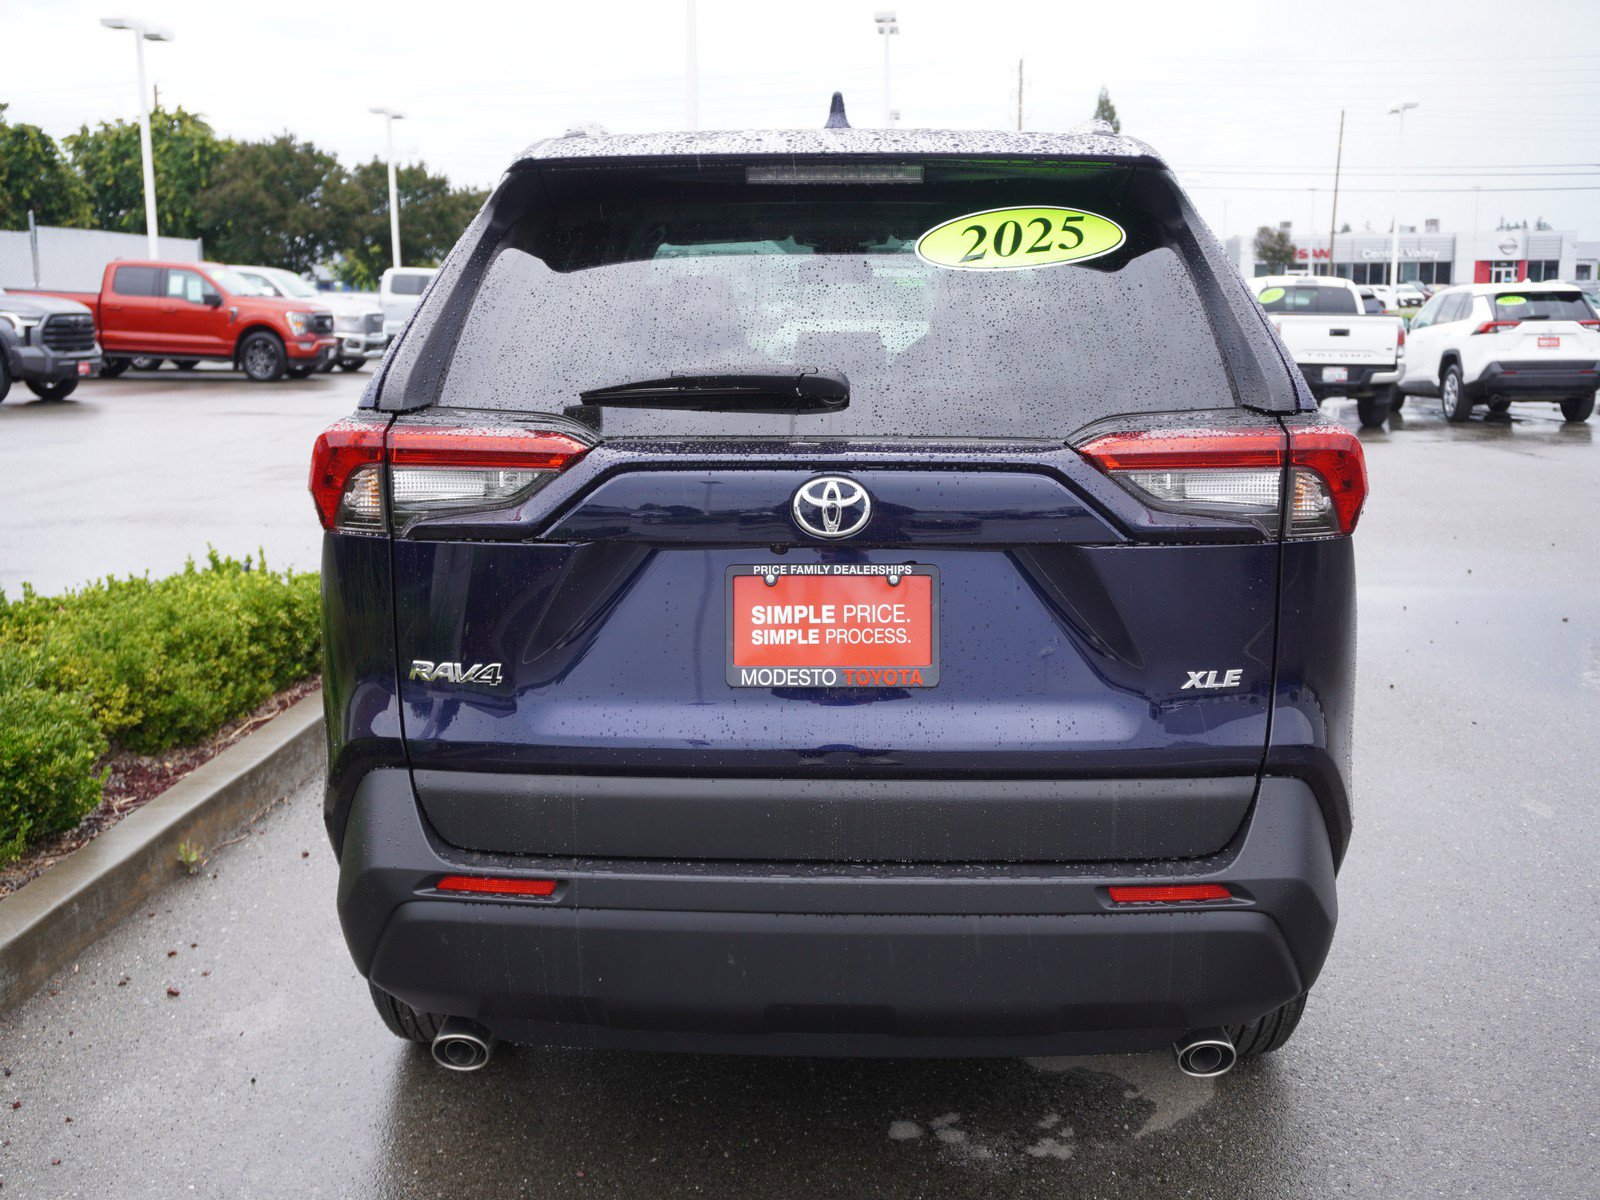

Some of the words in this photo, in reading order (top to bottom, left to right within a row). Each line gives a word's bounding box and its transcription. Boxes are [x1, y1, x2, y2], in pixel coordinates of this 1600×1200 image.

[958, 215, 1085, 264] 2025
[753, 565, 787, 575] PRICE
[790, 565, 830, 575] FAMILY
[833, 565, 912, 575] DEALERSHIPS
[751, 605, 836, 625] SIMPLE
[843, 604, 911, 623] PRICE.
[751, 629, 820, 645] SIMPLE
[825, 628, 912, 644] PROCESS.
[409, 660, 503, 686] RAV4
[741, 668, 837, 686] MODESTO
[842, 669, 923, 686] TOYOTA
[1181, 669, 1243, 689] XLE
